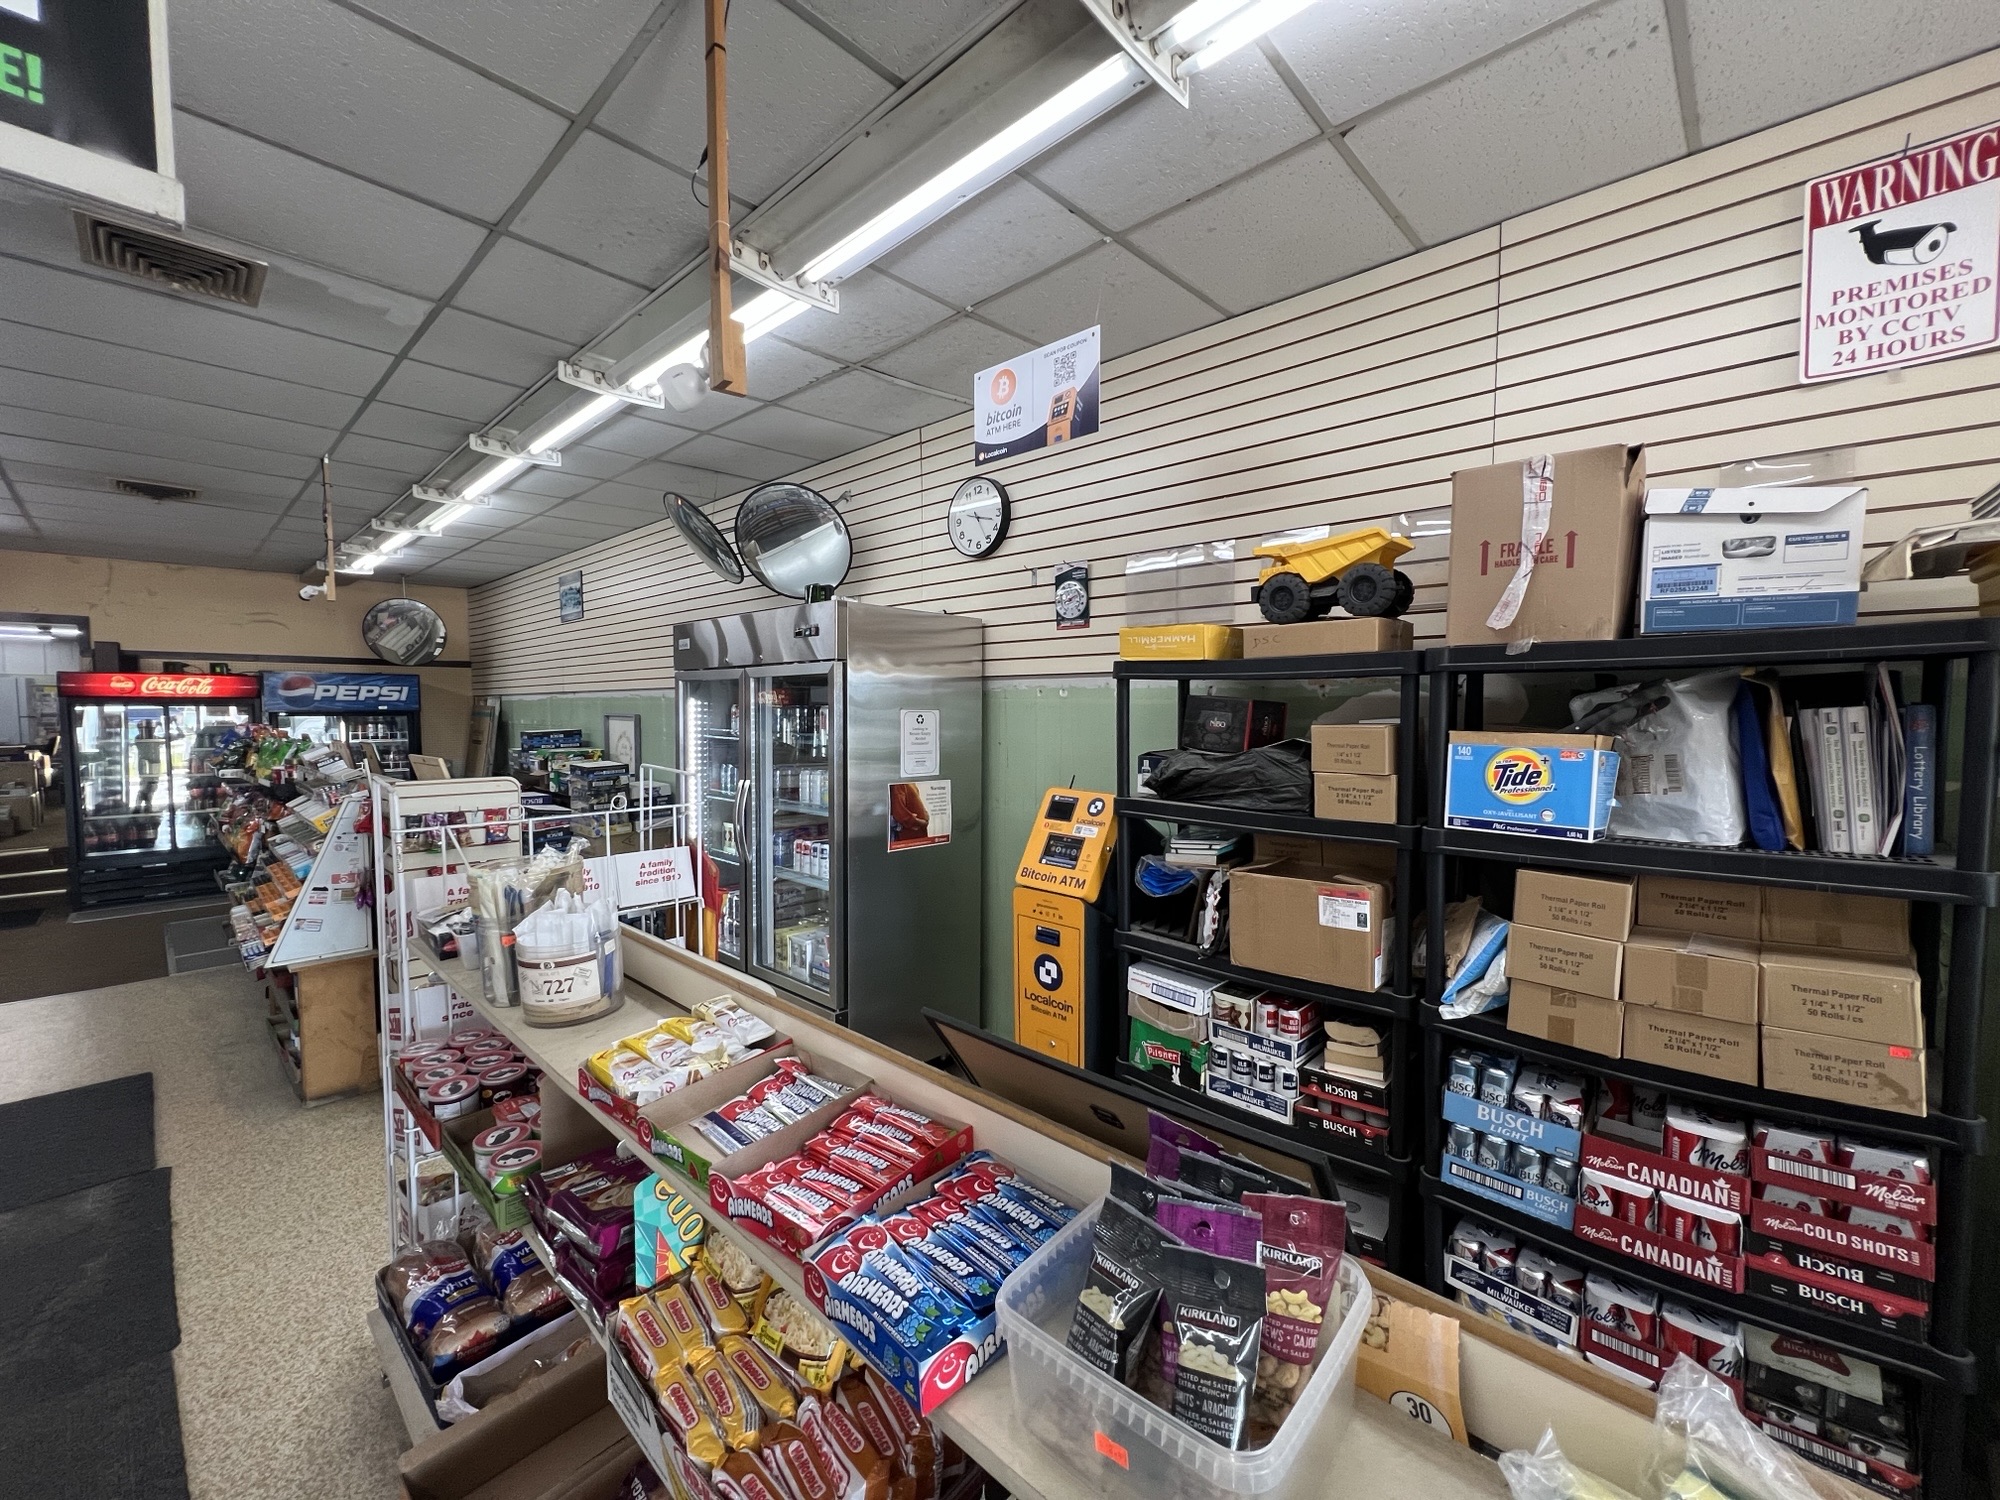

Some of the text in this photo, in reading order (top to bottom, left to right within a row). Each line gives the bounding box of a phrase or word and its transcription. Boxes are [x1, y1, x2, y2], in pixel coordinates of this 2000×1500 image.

[1818, 131, 2000, 225] WARNING
[1830, 258, 1974, 307] PREMISES
[1814, 275, 1992, 331] MONITORED
[1838, 304, 1963, 346] BY CCTV
[1832, 325, 1966, 367] 24 HOURS
[986, 403, 1022, 426] bitcoin
[985, 418, 1022, 438] ATM HERE
[985, 446, 1008, 459] Localcoin
[965, 492, 972, 501] 11
[973, 484, 983, 495] 12
[986, 487, 990, 496] 1
[996, 508, 1002, 518] 3
[956, 518, 962, 528] 9
[993, 522, 999, 532] 4
[959, 531, 965, 540] 8
[967, 539, 973, 549] 7
[985, 534, 992, 544] 5
[976, 541, 982, 550] 6
[1500, 539, 1555, 559] FRALE
[1540, 555, 1559, 565] CARE
[141, 675, 215, 695] Coca-Cola
[314, 685, 409, 701] PEPSI
[1457, 746, 1472, 756] 140
[1494, 763, 1542, 791] Tide
[1500, 784, 1554, 794] Professionnel
[1908, 746, 1929, 840] Lottery Library
[1076, 818, 1106, 827] Localcoin
[1483, 809, 1537, 820] OXY-JAVELLISANT
[639, 866, 676, 877] tradition
[648, 859, 674, 868] family
[635, 876, 660, 887] since
[1020, 866, 1087, 890] Bitcoin ATM
[1541, 893, 1606, 910] Thermal Paper Roll
[1661, 892, 1745, 908] Thermal Paper Roll
[1529, 942, 1594, 960] Thermal Paper Roll
[543, 977, 575, 995] 727
[1791, 984, 1883, 1004] Thermal Paper Roll
[1024, 988, 1074, 1014] Localcoin
[1031, 1004, 1067, 1021] Bitcoin ATM
[1820, 1011, 1845, 1021] Rolls
[1852, 1016, 1864, 1024] cs
[1263, 1039, 1275, 1048] OLD
[1649, 1024, 1740, 1047] Thermal Paper Roll
[1146, 1046, 1178, 1061] Pilsner
[1252, 1043, 1285, 1058] MILWAUKEE
[1664, 1043, 1674, 1051] 50
[1676, 1045, 1701, 1056] Rolls
[1794, 1049, 1886, 1069] Thermal Paper Roll
[1812, 1073, 1822, 1081] 50
[1825, 1075, 1850, 1086] Rolls
[1857, 1081, 1868, 1089] cs
[1232, 1091, 1265, 1107] MILWAUKEE
[1242, 1087, 1254, 1096] OLD
[1325, 1084, 1358, 1101] BUSCH
[1323, 1119, 1357, 1138] BUSCH
[1477, 1104, 1544, 1139] BUSCH
[1490, 1124, 1530, 1142] LIGHT
[833, 1145, 891, 1169] AIRHEADS
[801, 1169, 864, 1193] AIRHEADS
[1586, 1154, 1730, 1207] Molson CANADIAN
[771, 1183, 835, 1210] AIRHEADS
[1526, 1189, 1569, 1213] BUSCH
[1861, 1183, 1926, 1205] Molson
[728, 1197, 774, 1228] AIRHEADS
[977, 1193, 1044, 1230] AIRHEADS
[1534, 1201, 1559, 1215] LIGHT
[946, 1211, 1017, 1249] AIRHEADS
[1763, 1217, 1909, 1262] Molson COLD SHOTS
[903, 1236, 974, 1277] AIRHEADS
[1262, 1246, 1323, 1269] KIRKLAND
[1580, 1224, 1722, 1285] Molson CANADIAN
[864, 1249, 923, 1297] AIRHEADS
[1096, 1254, 1140, 1290] KIRKLAND
[1797, 1253, 1865, 1283] BUSCH
[838, 1272, 910, 1320] AIRHEADS
[1503, 1285, 1520, 1299] OLD
[1798, 1284, 1865, 1314] BUSCH
[1486, 1287, 1536, 1317] MILWAUKEE
[824, 1295, 876, 1344] AIRHEADS
[873, 1311, 884, 1323] BLUE
[1179, 1306, 1238, 1328] KIRKLAND
[1282, 1322, 1318, 1335] and SALTED
[1782, 1340, 1812, 1357] HIGH
[1178, 1379, 1197, 1392] EXTRA
[1197, 1385, 1230, 1400] CRUNCHY
[1200, 1378, 1237, 1393] and SALTED
[1406, 1396, 1433, 1425] 30
